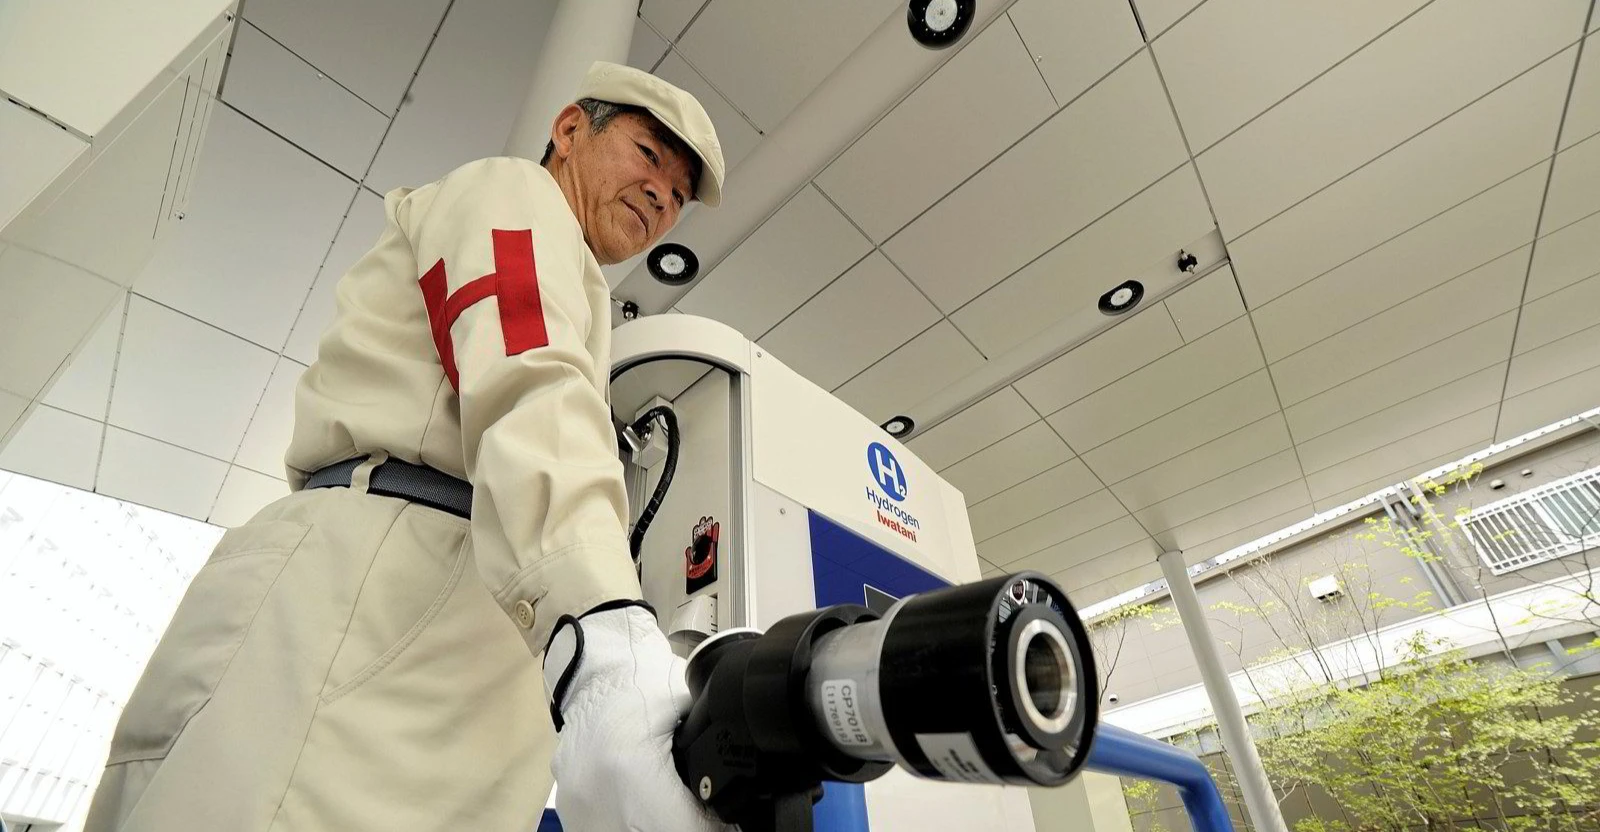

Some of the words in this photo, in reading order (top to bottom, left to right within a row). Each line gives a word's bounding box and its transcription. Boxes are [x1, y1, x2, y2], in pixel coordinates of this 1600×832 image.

[418, 228, 549, 397] H
[866, 486, 920, 530] Hydrogen
[877, 510, 917, 543] Iwatani
